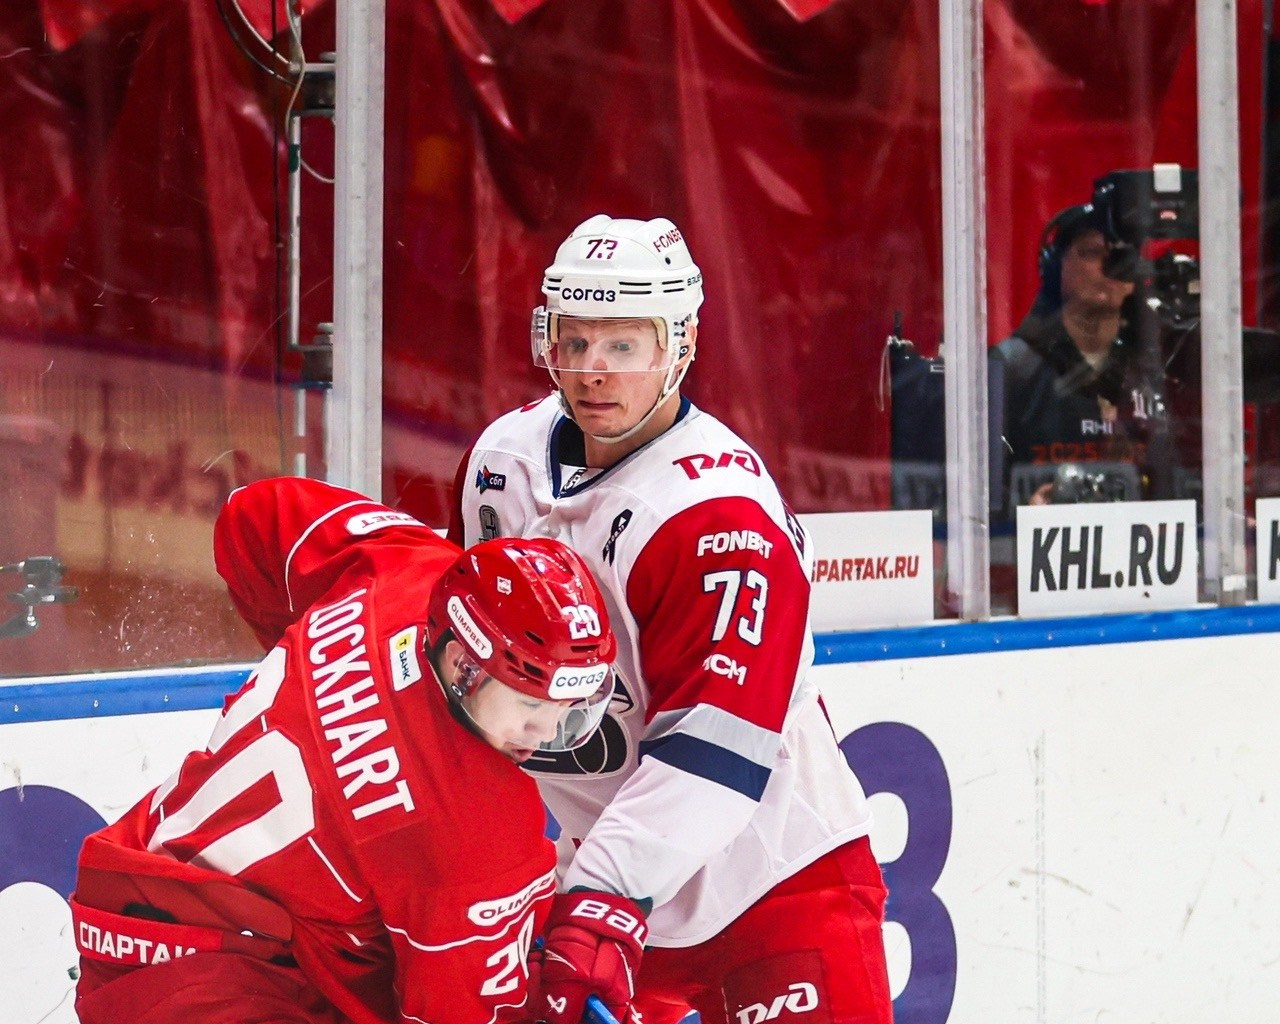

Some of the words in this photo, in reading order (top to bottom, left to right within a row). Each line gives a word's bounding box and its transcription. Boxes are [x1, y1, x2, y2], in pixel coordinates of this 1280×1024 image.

[652, 228, 682, 253] FONBE
[561, 287, 617, 303] согаз
[1030, 522, 1184, 592] KHL.RU
[450, 603, 488, 652] OLIMPBET
[560, 604, 602, 640] 20
[702, 568, 769, 647] 73
